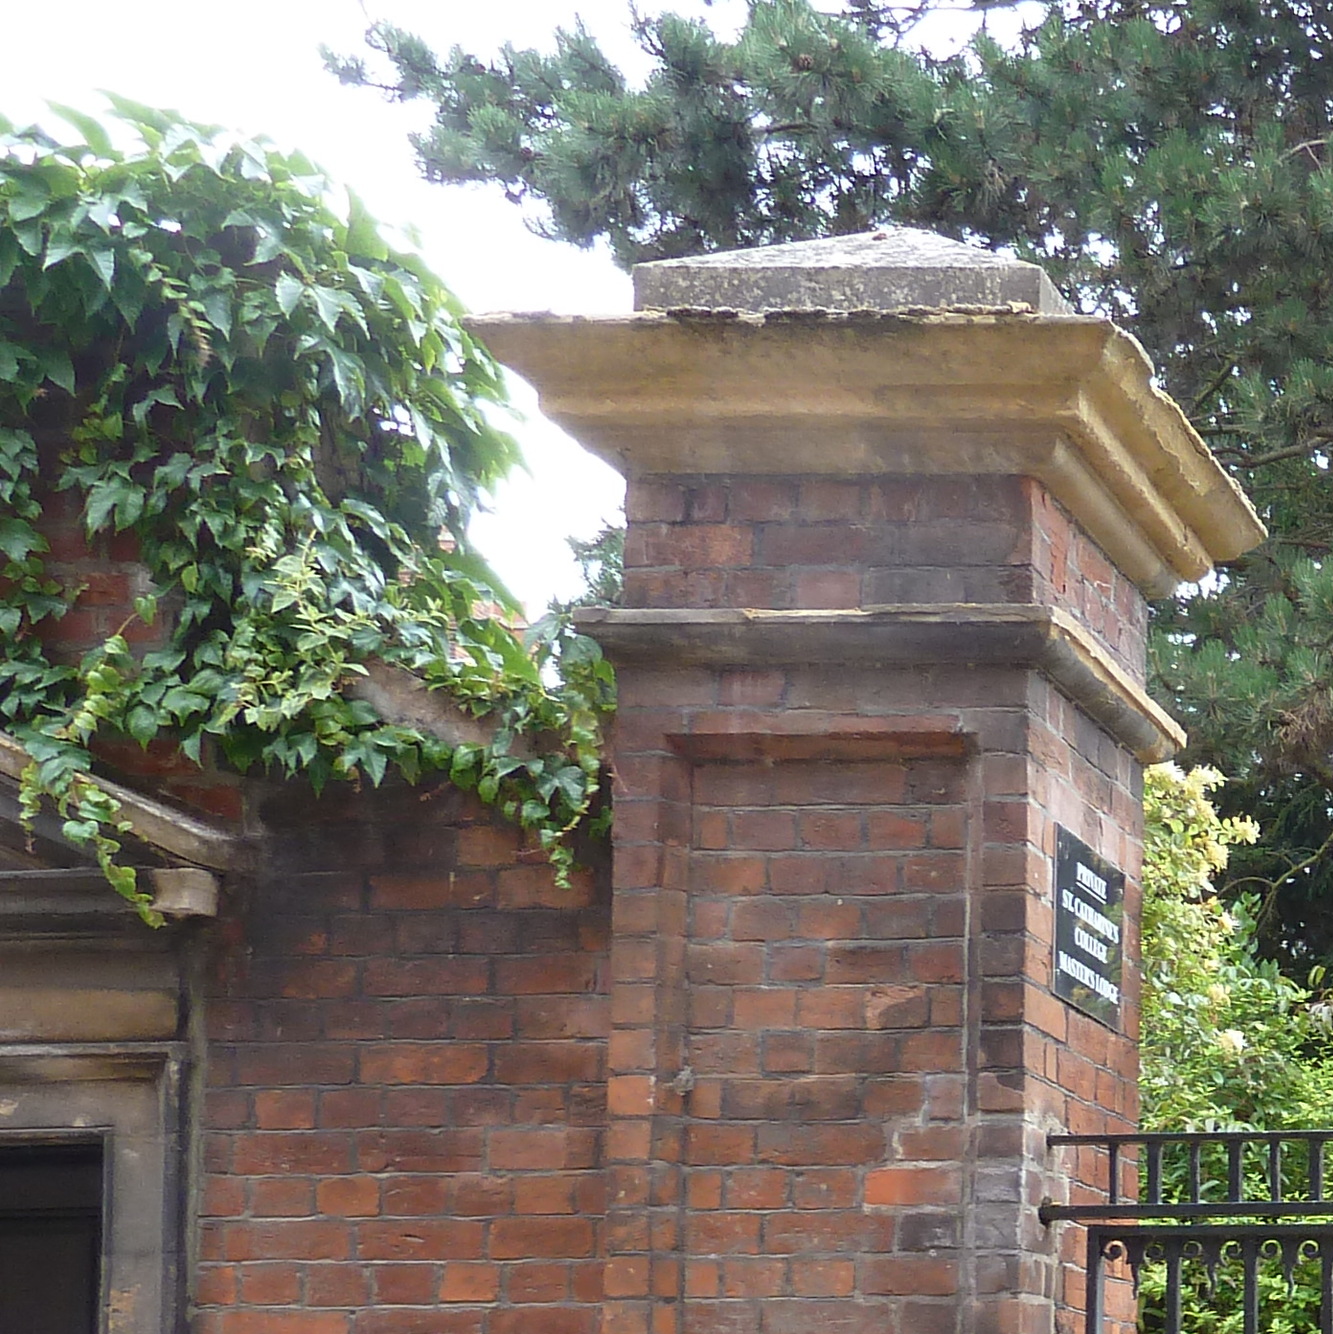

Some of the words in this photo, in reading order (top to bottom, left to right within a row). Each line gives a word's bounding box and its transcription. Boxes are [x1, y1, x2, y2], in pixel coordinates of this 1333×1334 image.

[1076, 862, 1107, 900] PRIVATE
[1074, 926, 1108, 964] COLLEGE
[1095, 974, 1119, 1005] LODGE
